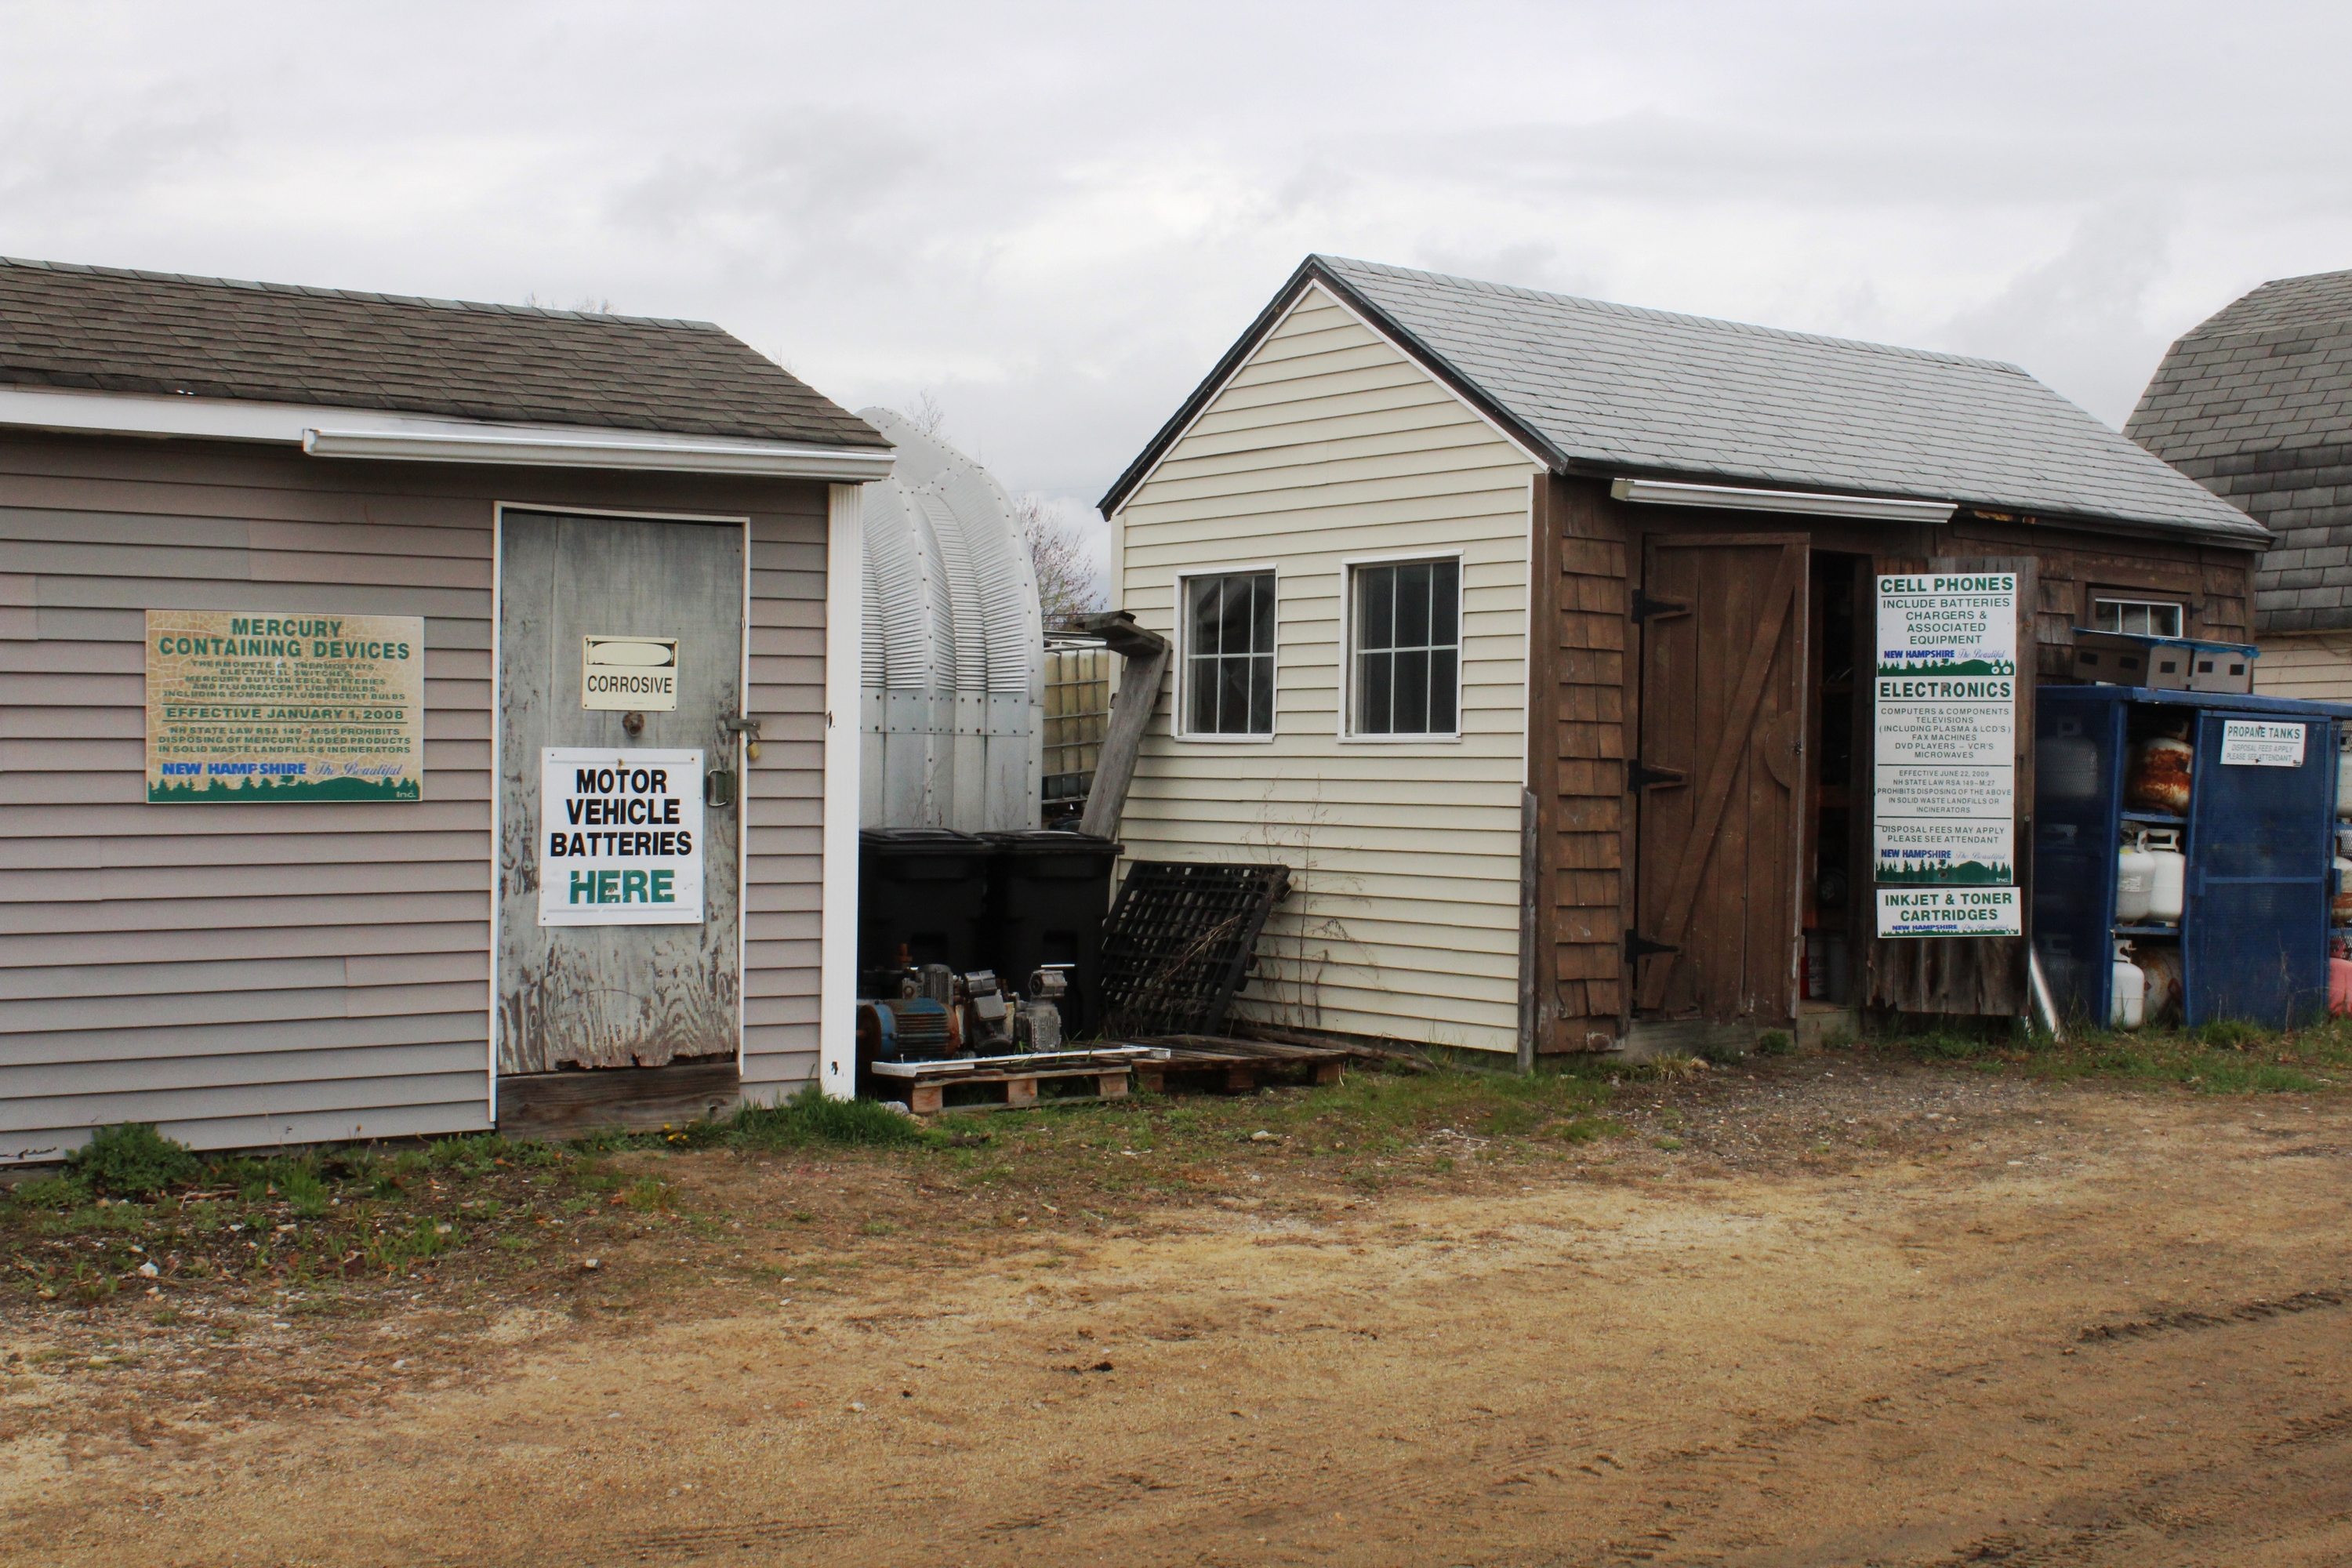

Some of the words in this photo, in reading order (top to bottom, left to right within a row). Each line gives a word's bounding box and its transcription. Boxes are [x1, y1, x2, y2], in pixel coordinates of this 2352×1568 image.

[1881, 579, 1927, 593] CELL
[1934, 577, 2013, 591] PHONES
[1883, 599, 1936, 608] INCLUDE
[1940, 598, 2010, 608] BATTERIES
[1906, 611, 1974, 620] CHARGERS
[1980, 611, 1987, 619] &
[231, 619, 342, 637] MERCURY
[1907, 622, 1986, 633] ASSOCIATED
[1910, 635, 1982, 644] EQUIPMENT
[159, 637, 301, 656] CONTAINING
[314, 641, 410, 660] DEVICES
[1906, 650, 1955, 659] HAMPSHIRE
[1958, 648, 1970, 659] The
[1973, 648, 2005, 659] Beautiful
[191, 660, 290, 669] THERMOMETES,
[587, 675, 673, 694] CORROSIVE
[1880, 682, 2011, 697] ELECTRONICS
[166, 708, 261, 718] EFFECTIVE
[267, 709, 343, 719] JANUARY
[348, 710, 358, 720] 1,
[363, 710, 403, 719] 2008
[2228, 725, 2266, 738] PROPANE
[2269, 728, 2300, 739] TANKS
[162, 763, 202, 775] NEW
[208, 763, 307, 775] HAMPSHIRE
[315, 761, 337, 775] The
[342, 762, 403, 778] Beautiful
[576, 769, 667, 794] MOTOR
[566, 799, 681, 826] VEHICLE
[550, 831, 692, 857] BATTERIES
[1881, 849, 1900, 858] NEW
[1902, 849, 1951, 858] HAMPSHIRE
[1972, 851, 2006, 860] Beautiful
[570, 869, 675, 904] HERE
[1885, 894, 1939, 906] INKJET
[1945, 894, 1955, 905] &
[1960, 893, 2012, 905] TONER
[1900, 909, 1998, 922] CARTRIDGES
